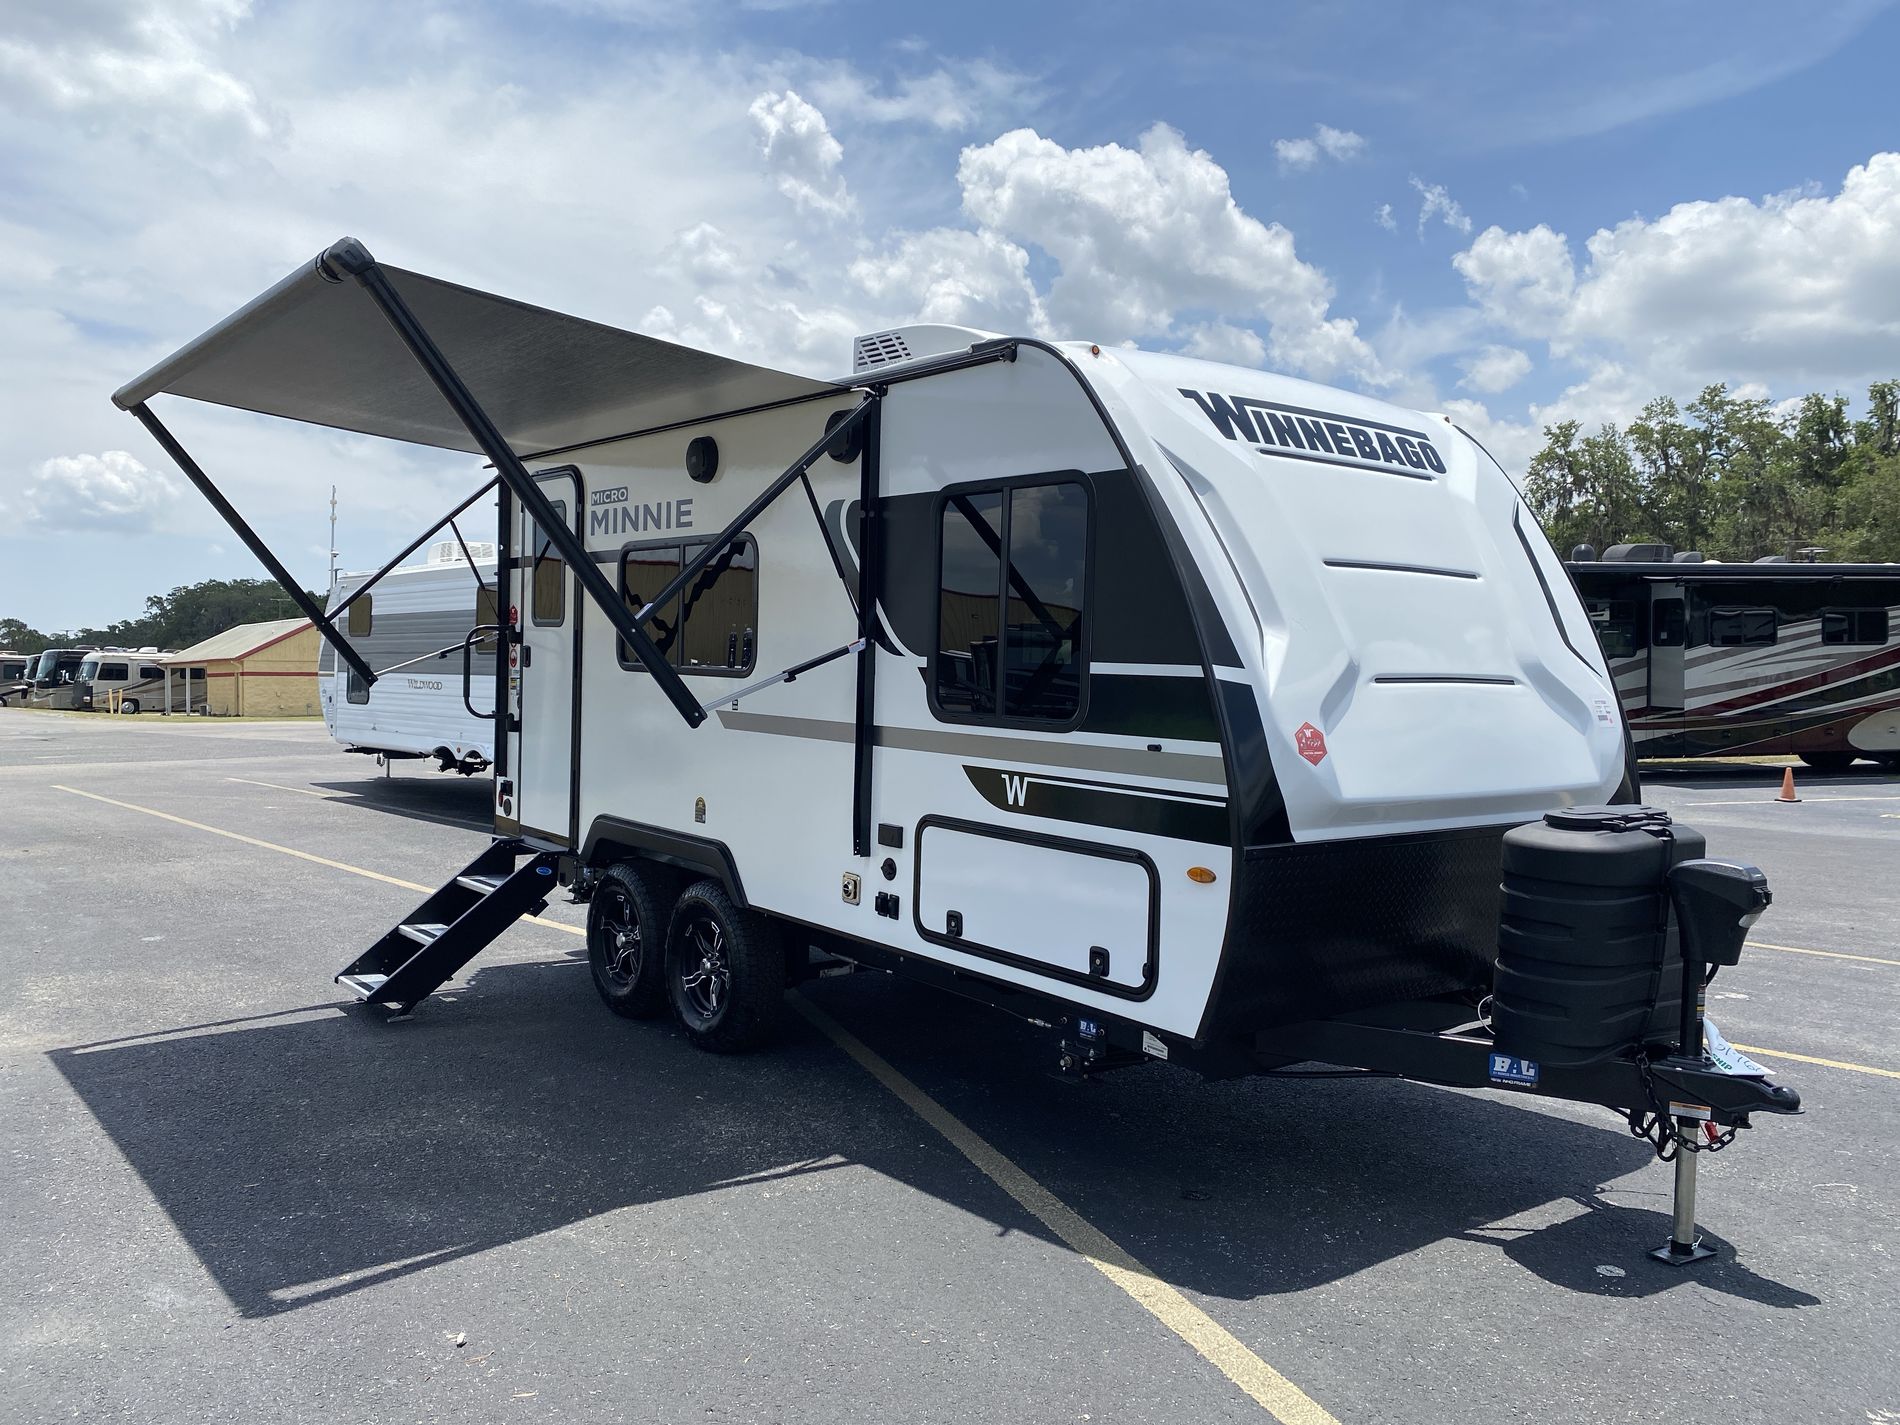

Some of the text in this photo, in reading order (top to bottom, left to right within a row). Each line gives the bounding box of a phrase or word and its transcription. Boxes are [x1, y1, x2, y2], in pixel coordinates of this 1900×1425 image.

[1177, 388, 1447, 474] WINNEBAGO
[591, 488, 628, 505] MICRO
[590, 499, 694, 537] MINNIE
[407, 678, 443, 691] WILDWOOD
[1001, 773, 1028, 807] W
[1493, 1056, 1536, 1077] BAL
